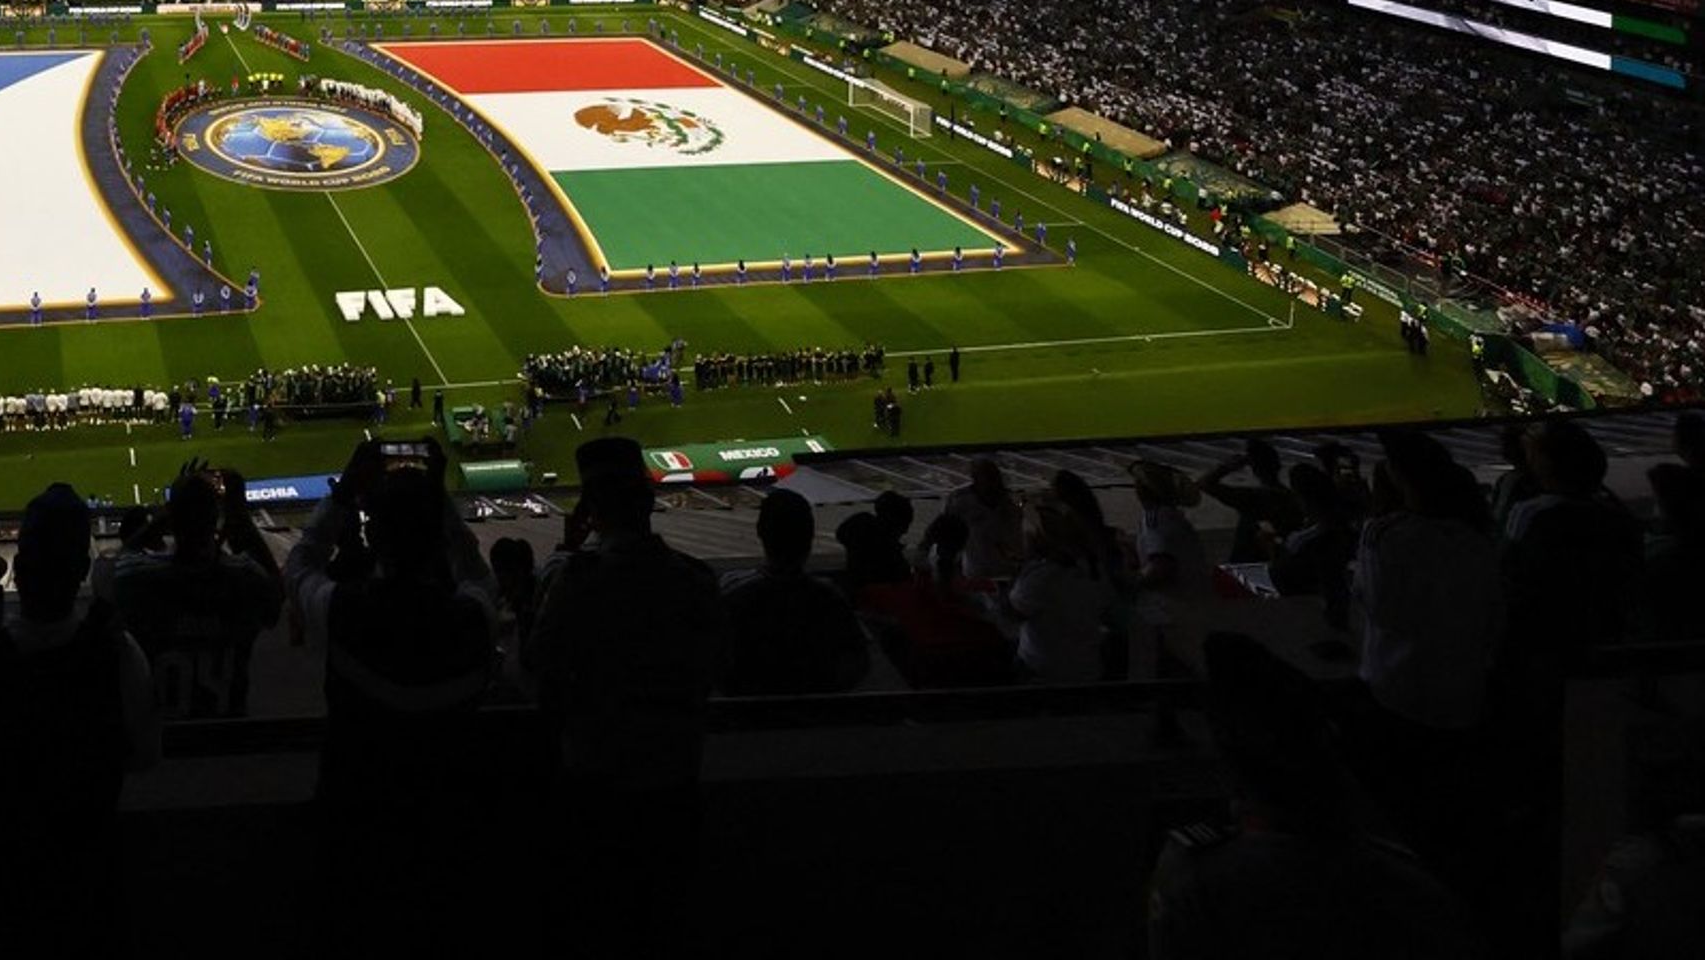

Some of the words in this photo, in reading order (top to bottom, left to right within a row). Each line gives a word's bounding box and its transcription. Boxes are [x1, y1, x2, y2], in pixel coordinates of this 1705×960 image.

[232, 168, 265, 185] FIFA
[267, 176, 321, 187] WORLD
[322, 177, 351, 187] CUP
[1130, 204, 1163, 229] WORLD
[334, 285, 467, 322] FIFA
[718, 447, 781, 462] MEXICO
